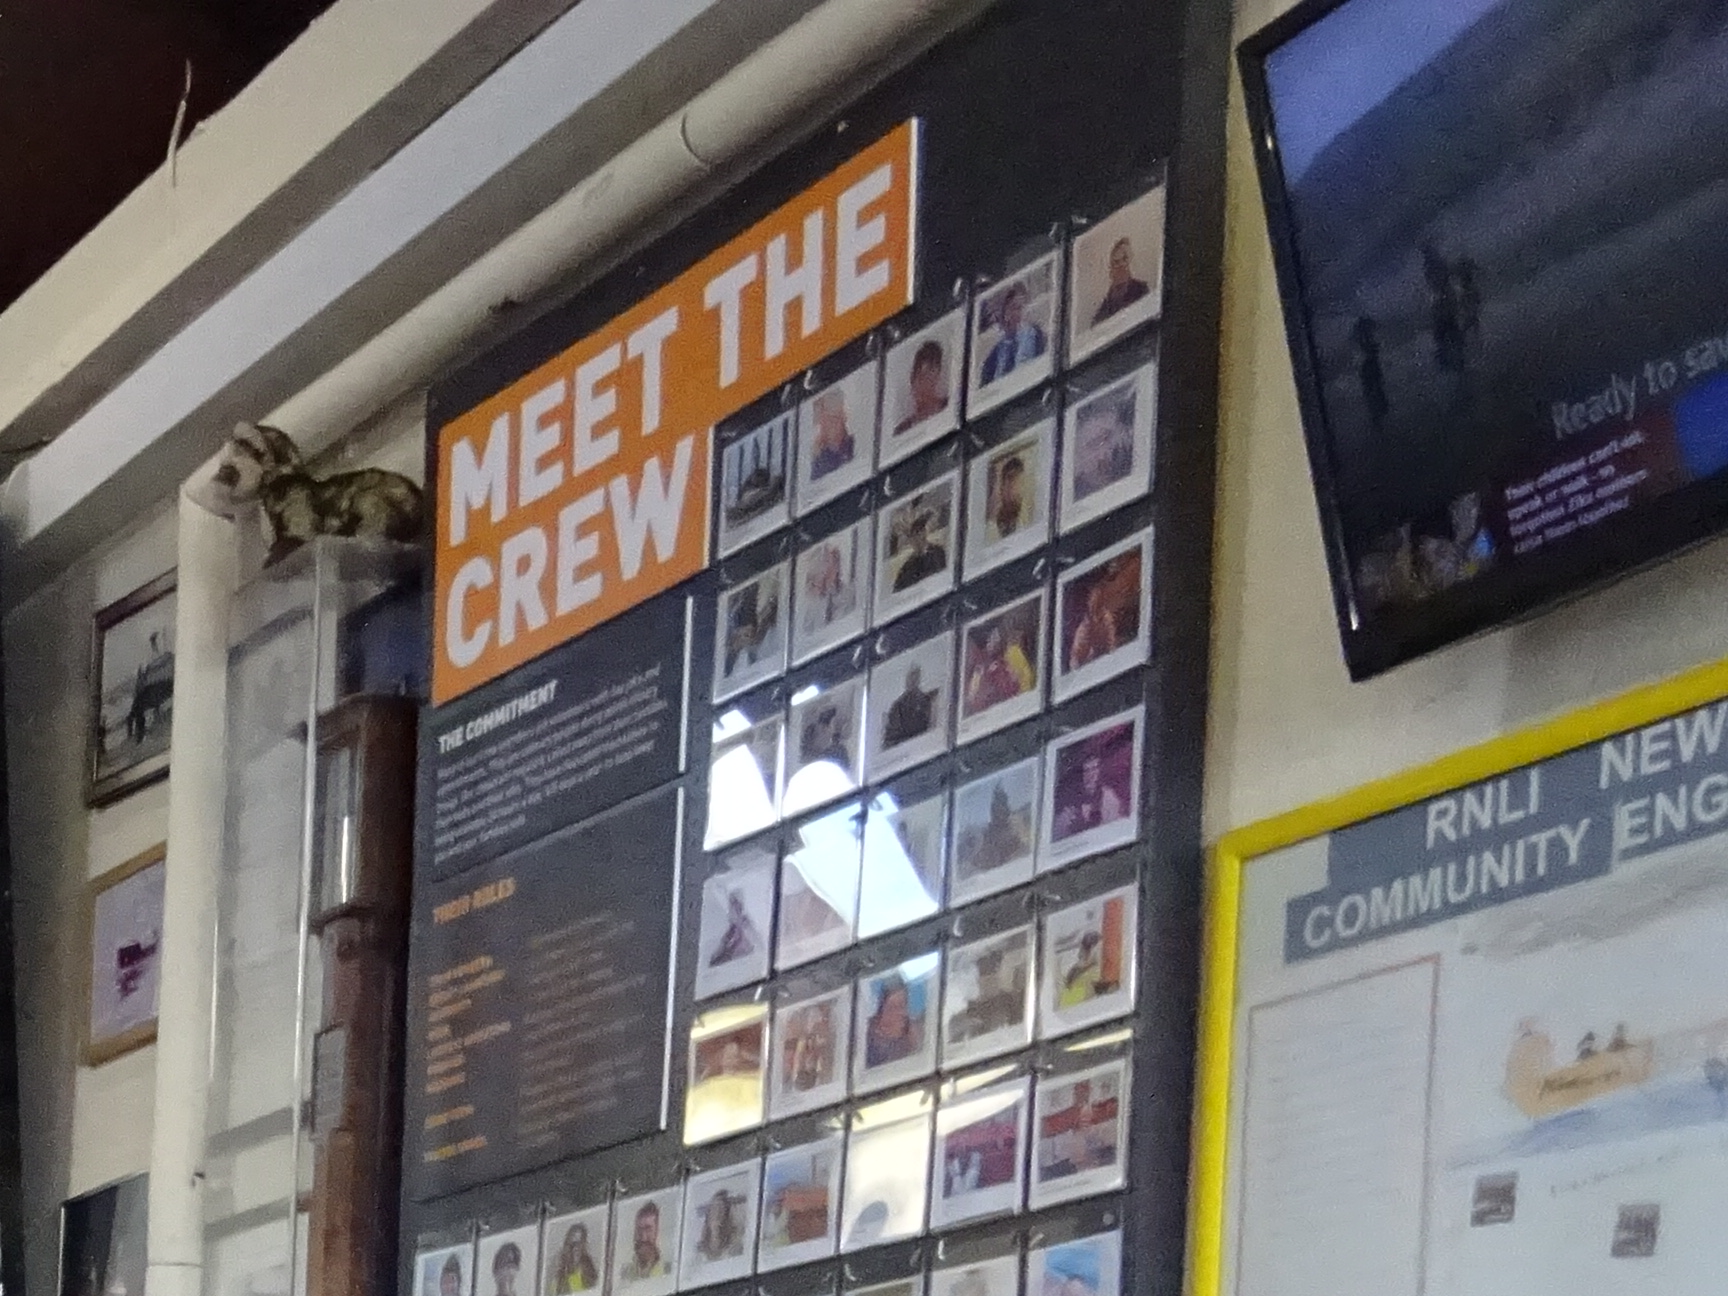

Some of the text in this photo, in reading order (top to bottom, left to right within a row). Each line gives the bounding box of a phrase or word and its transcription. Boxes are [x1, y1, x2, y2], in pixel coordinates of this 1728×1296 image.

[449, 163, 893, 549] MEET THE
[1552, 373, 1637, 440] Ready
[1645, 360, 1679, 396] to
[446, 434, 696, 669] CREW
[1426, 767, 1541, 850] RNLI
[1303, 818, 1592, 950] COMMUNITY
